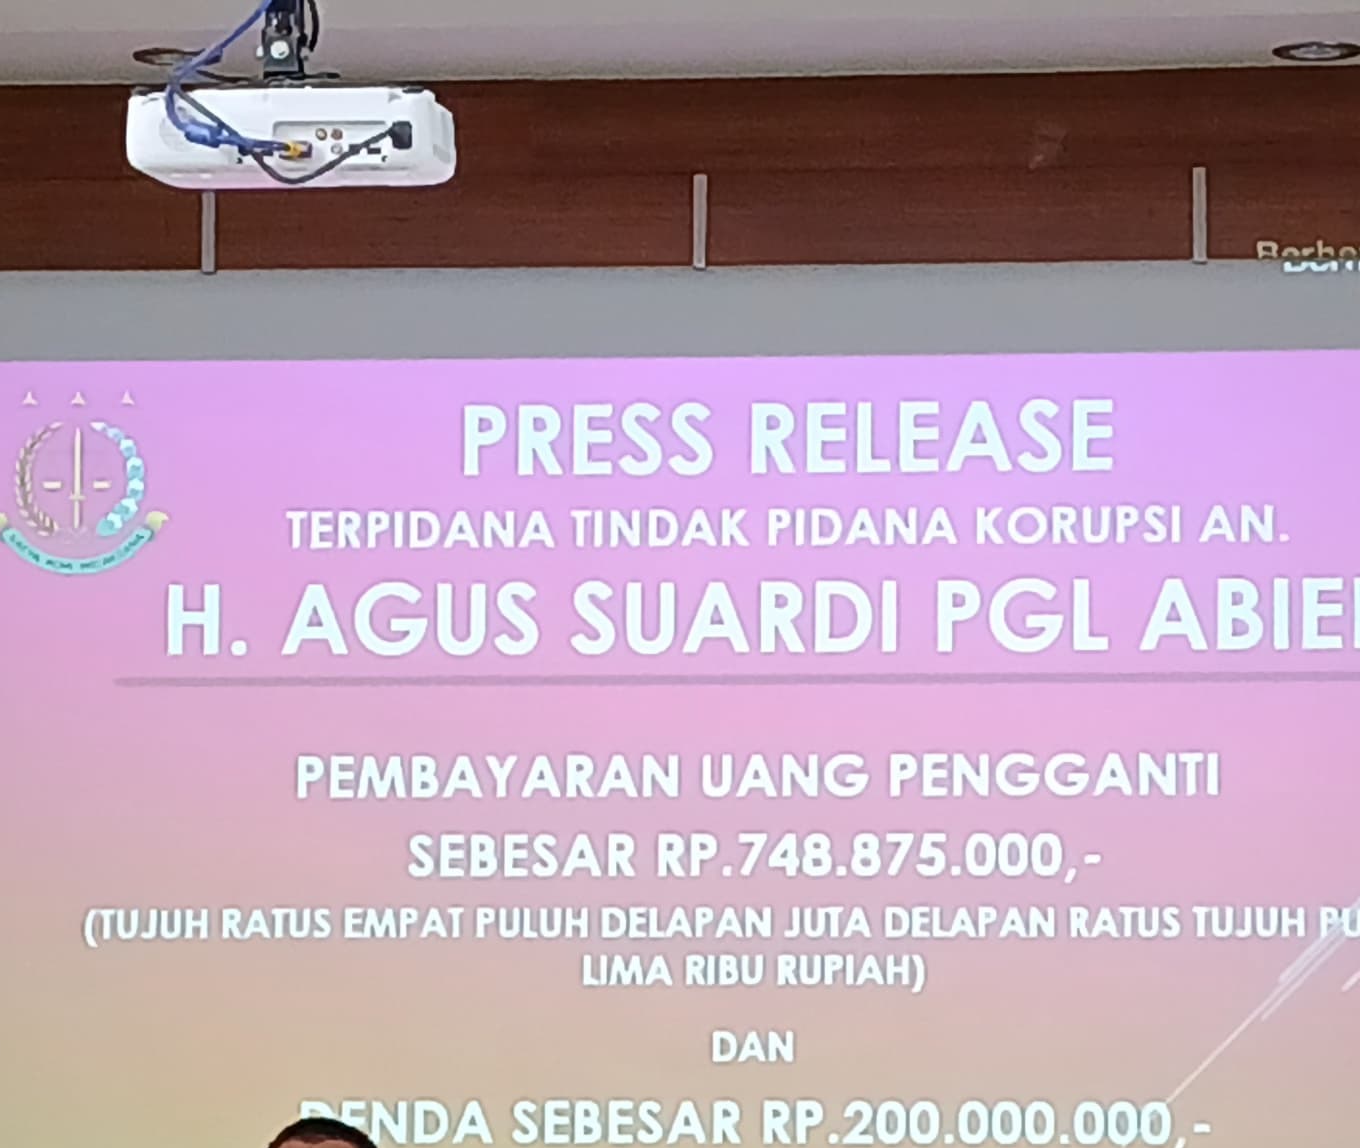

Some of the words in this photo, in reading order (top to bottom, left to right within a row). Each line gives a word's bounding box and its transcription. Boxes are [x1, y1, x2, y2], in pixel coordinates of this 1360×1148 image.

[463, 402, 713, 476] PRESS
[751, 398, 1114, 474] RELEASE
[285, 510, 555, 550] TERPIDANA
[570, 508, 750, 548] TINDAK
[768, 507, 958, 547] PIDANA
[976, 505, 1181, 545] KORUPSI
[1199, 503, 1290, 543] AN.
[167, 583, 248, 656] H.
[281, 581, 539, 656] AGUS
[570, 580, 897, 655] SUARDI
[937, 578, 1109, 653] PGL
[297, 754, 679, 799] PEMBAYARAN
[702, 753, 869, 798] UANG
[889, 752, 1219, 797] PENGGANTI
[408, 833, 636, 877] SEBESAR
[657, 832, 1101, 884] RP.748.875.000,-
[84, 908, 209, 948] (TUJUH
[222, 907, 332, 939] RATUS
[343, 907, 465, 939] EMPAT
[475, 907, 588, 938] PULUH
[601, 906, 772, 938] DELAPAN
[783, 906, 872, 938] JUTA
[885, 906, 1055, 938] DELAPAN
[1069, 906, 1181, 938] RATUS
[1191, 905, 1306, 938] TUJUH
[583, 954, 673, 986] LIMA
[685, 954, 764, 986] RIBU
[777, 954, 925, 993] RUPIAH)
[712, 1030, 794, 1063] DAN
[512, 1100, 741, 1145] SEBESAR
